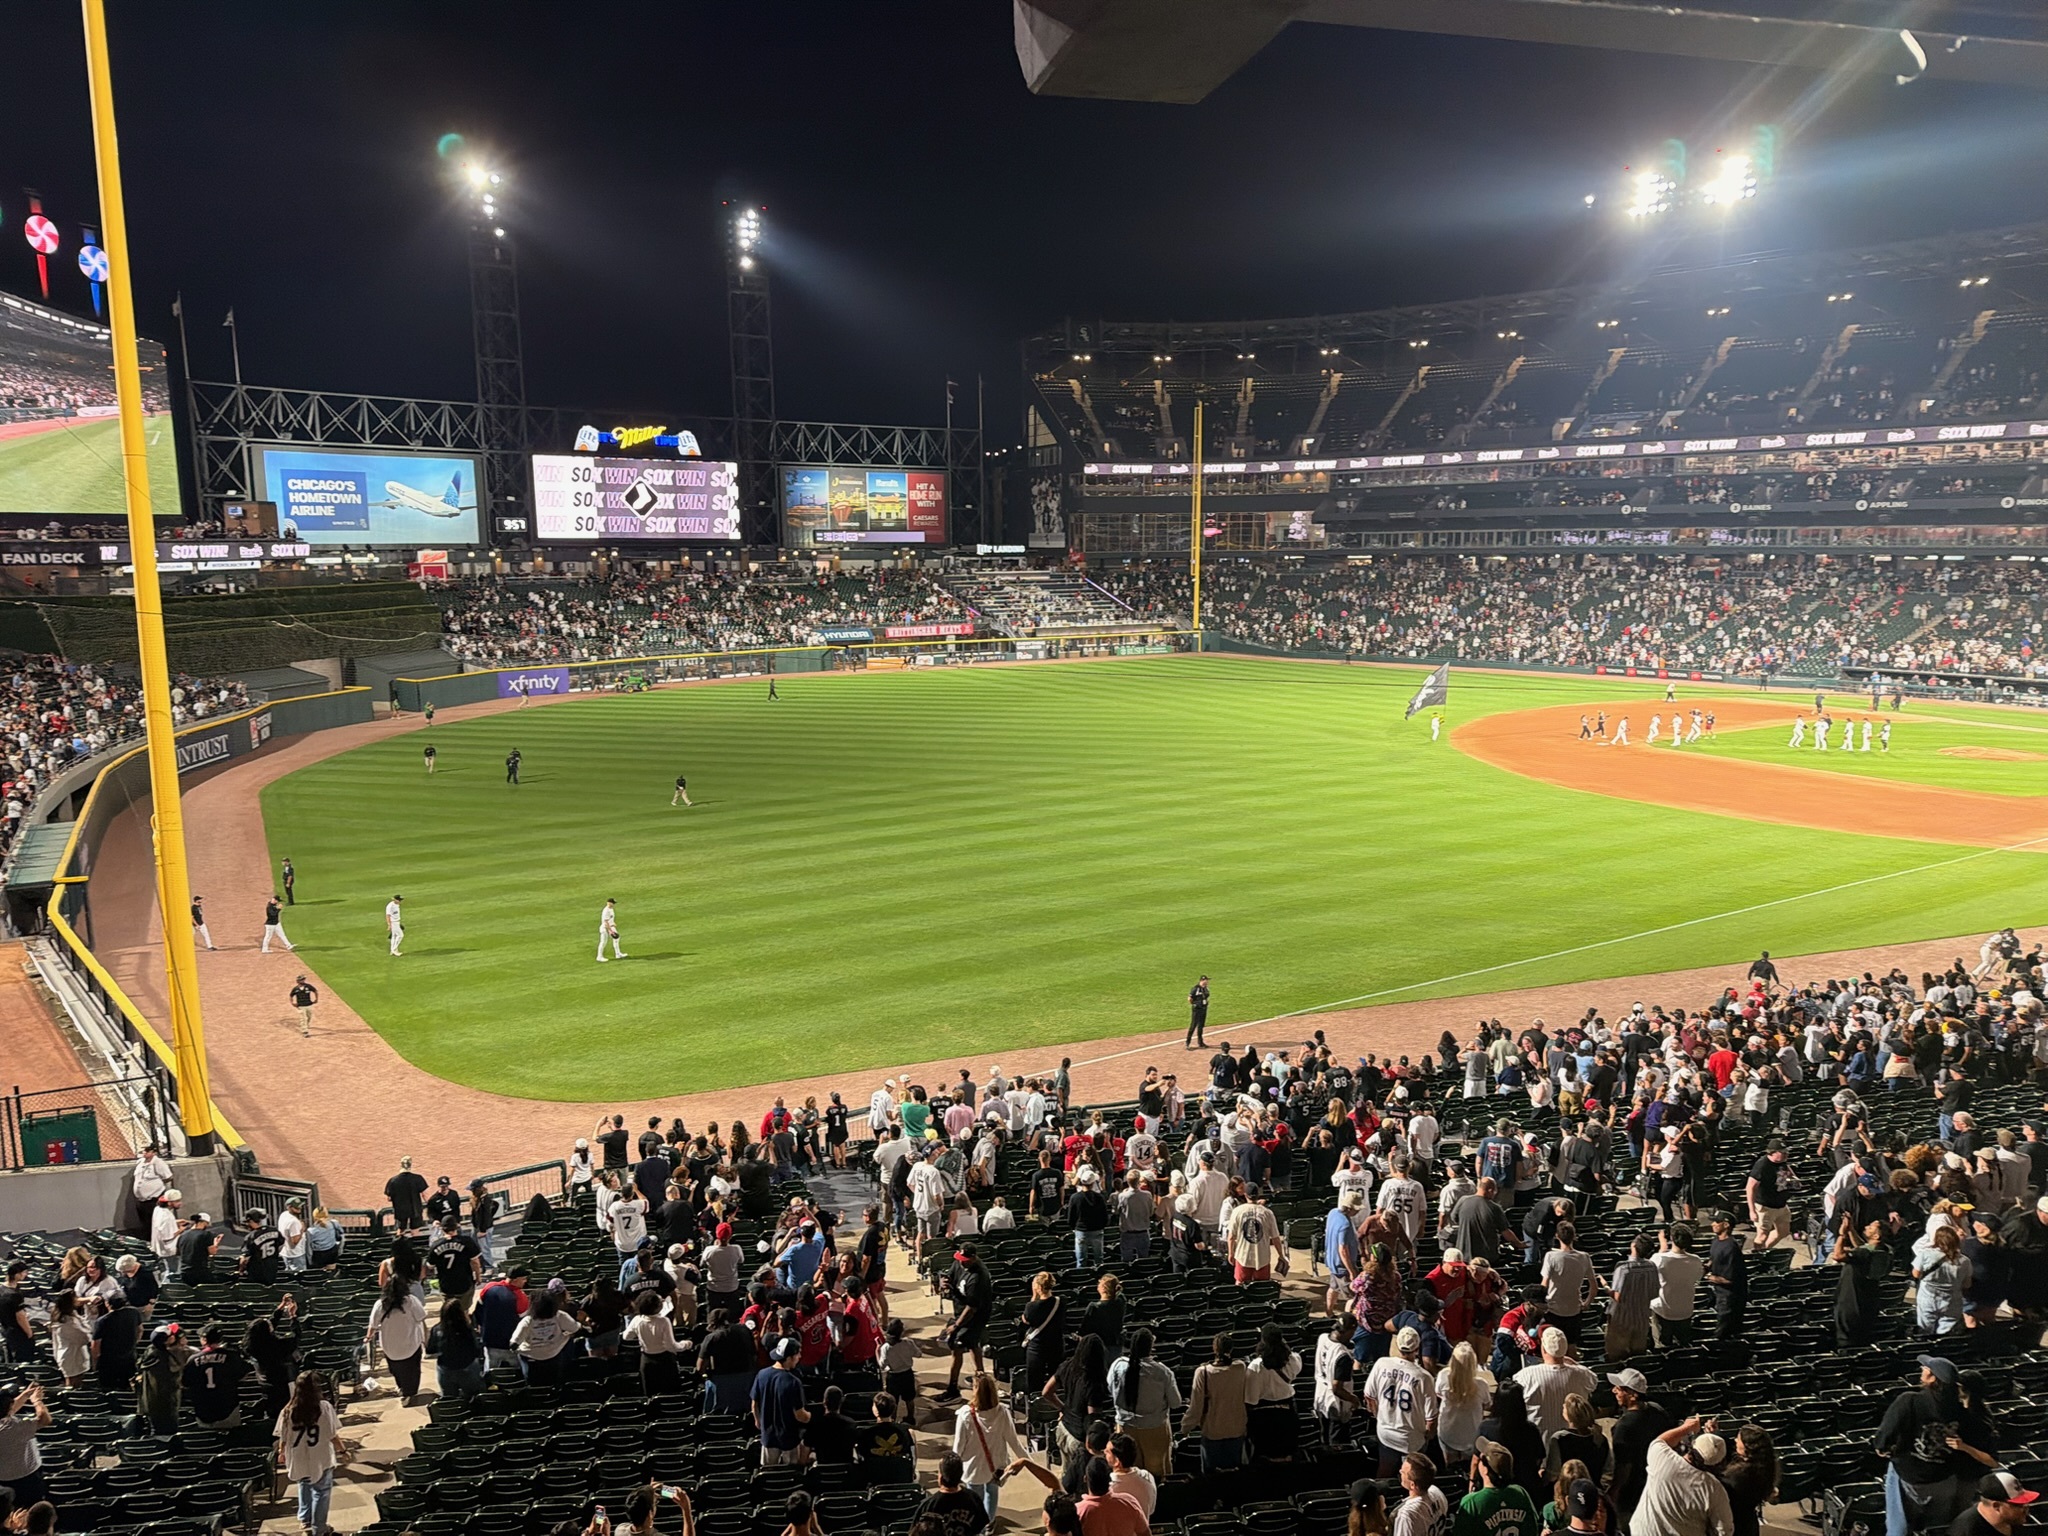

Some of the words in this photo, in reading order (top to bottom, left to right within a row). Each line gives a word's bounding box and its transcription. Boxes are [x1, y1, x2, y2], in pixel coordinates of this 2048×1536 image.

[580, 430, 596, 443] Lite
[612, 426, 667, 449] Miller
[1937, 426, 1970, 439] SOX
[605, 467, 637, 484] WIN
[643, 469, 675, 486] SOX
[675, 470, 706, 486] WIN
[287, 478, 356, 491] CHICAGO'S
[289, 492, 362, 504] HOMETOWN
[677, 494, 708, 510] WIN
[909, 490, 928, 500] HOME
[929, 491, 942, 500] RUN
[289, 505, 335, 516] AIRLINE
[608, 516, 640, 533] WIN
[645, 517, 677, 533] SOX
[678, 518, 709, 533] WIN
[172, 545, 198, 559] SOX
[200, 545, 229, 557] WIN!
[271, 544, 292, 557] SOX
[2, 553, 37, 564] FAN
[40, 553, 85, 564] DECK
[824, 631, 870, 639] HYUNDAI
[658, 659, 678, 668] THE
[507, 673, 560, 693] xfinity
[175, 734, 229, 767] INTRUST
[1333, 1076, 1348, 1089] 88
[937, 1107, 946, 1119] 5
[1302, 1105, 1310, 1116] 5
[834, 1115, 841, 1126] 1
[1138, 1147, 1151, 1160] 14
[917, 1179, 924, 1192] 5
[1393, 1198, 1413, 1213] 65
[622, 1216, 632, 1230] 7
[260, 1240, 276, 1259] 15
[443, 1254, 455, 1269] 7
[193, 1353, 227, 1367] FAMILIA
[204, 1367, 216, 1389] 1
[1381, 1368, 1419, 1387] deGROM
[1383, 1385, 1413, 1412] 48
[292, 1425, 320, 1448] 79
[1485, 1508, 1527, 1530] PIERZYNSKI
